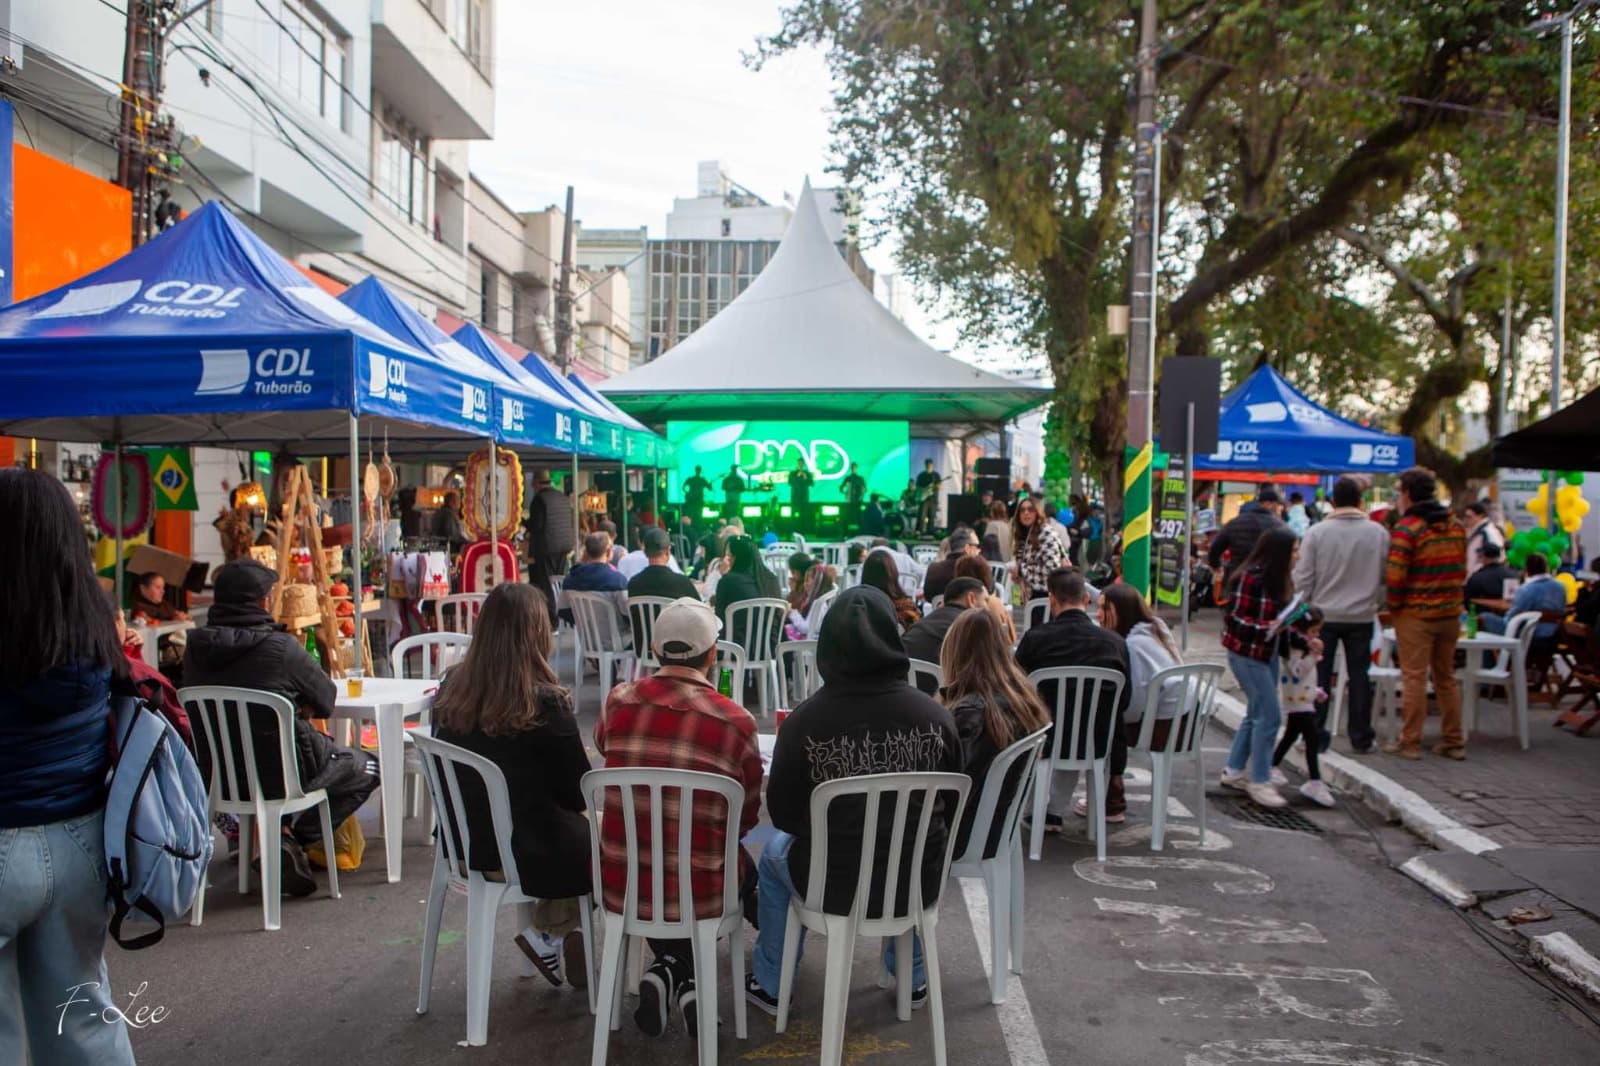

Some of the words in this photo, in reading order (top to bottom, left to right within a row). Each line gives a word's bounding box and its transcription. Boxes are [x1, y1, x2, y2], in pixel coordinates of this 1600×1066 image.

[144, 280, 245, 307] CDL
[128, 303, 226, 318] Tubarão
[255, 348, 315, 377] CDL
[388, 358, 408, 387] CDL
[254, 381, 312, 395] Tubarão
[1234, 440, 1260, 454] CDL
[1374, 445, 1400, 458] CDL
